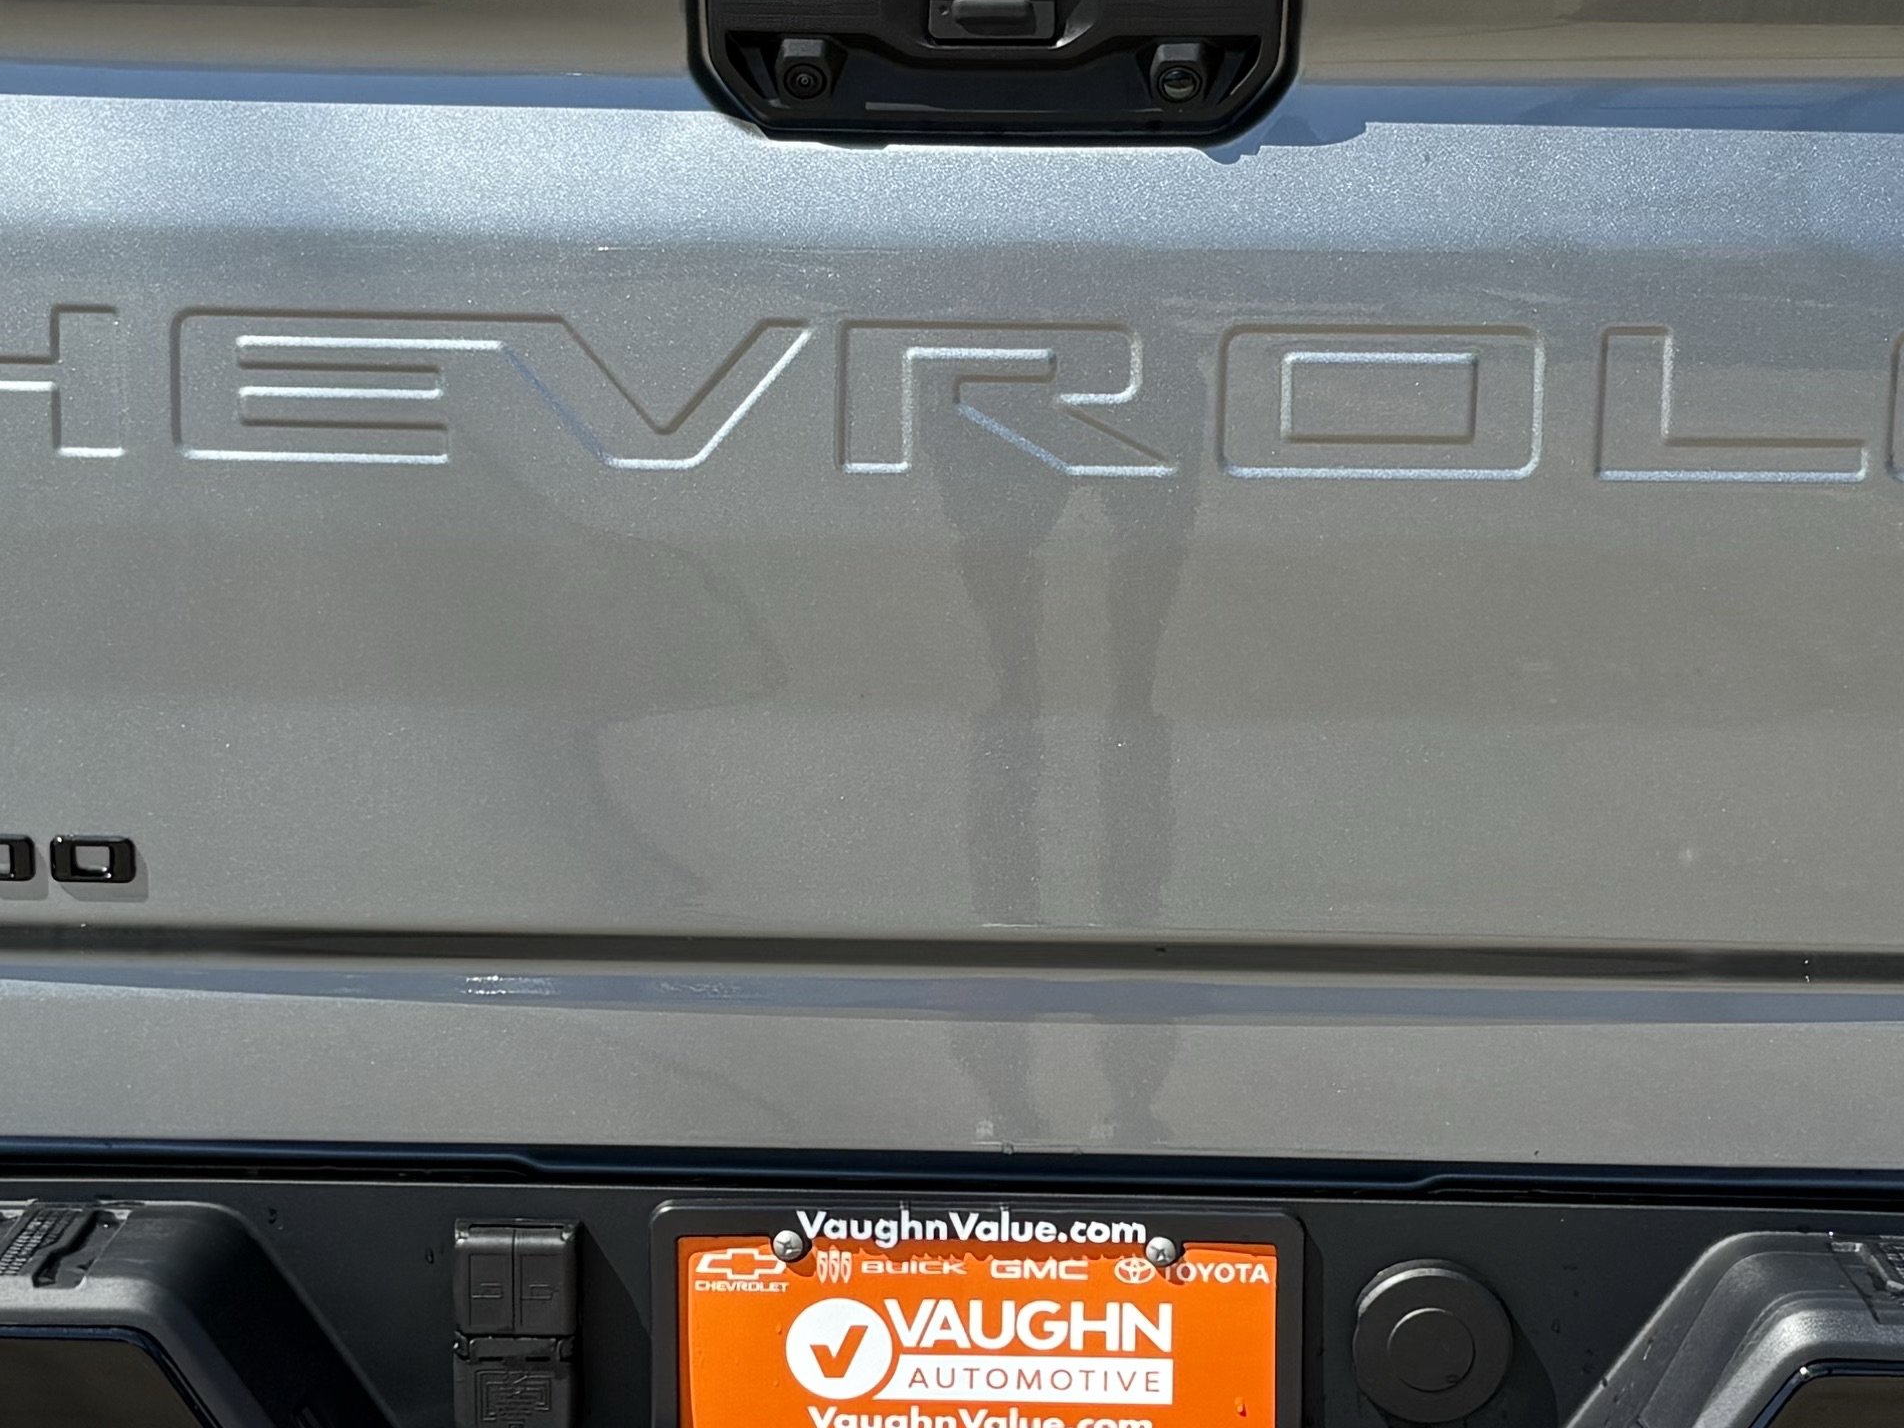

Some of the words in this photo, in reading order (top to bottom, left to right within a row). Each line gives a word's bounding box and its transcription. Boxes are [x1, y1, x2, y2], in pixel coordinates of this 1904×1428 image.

[797, 1209, 1146, 1248] VaughnValue.com
[861, 1260, 967, 1275] BUICK
[990, 1259, 1088, 1281] GMC
[1164, 1262, 1270, 1284] TOYOTA
[694, 1280, 790, 1293] CHEVROLET
[883, 1298, 1173, 1353] VAUGHN
[908, 1367, 1160, 1393] AUTOMOTIVE
